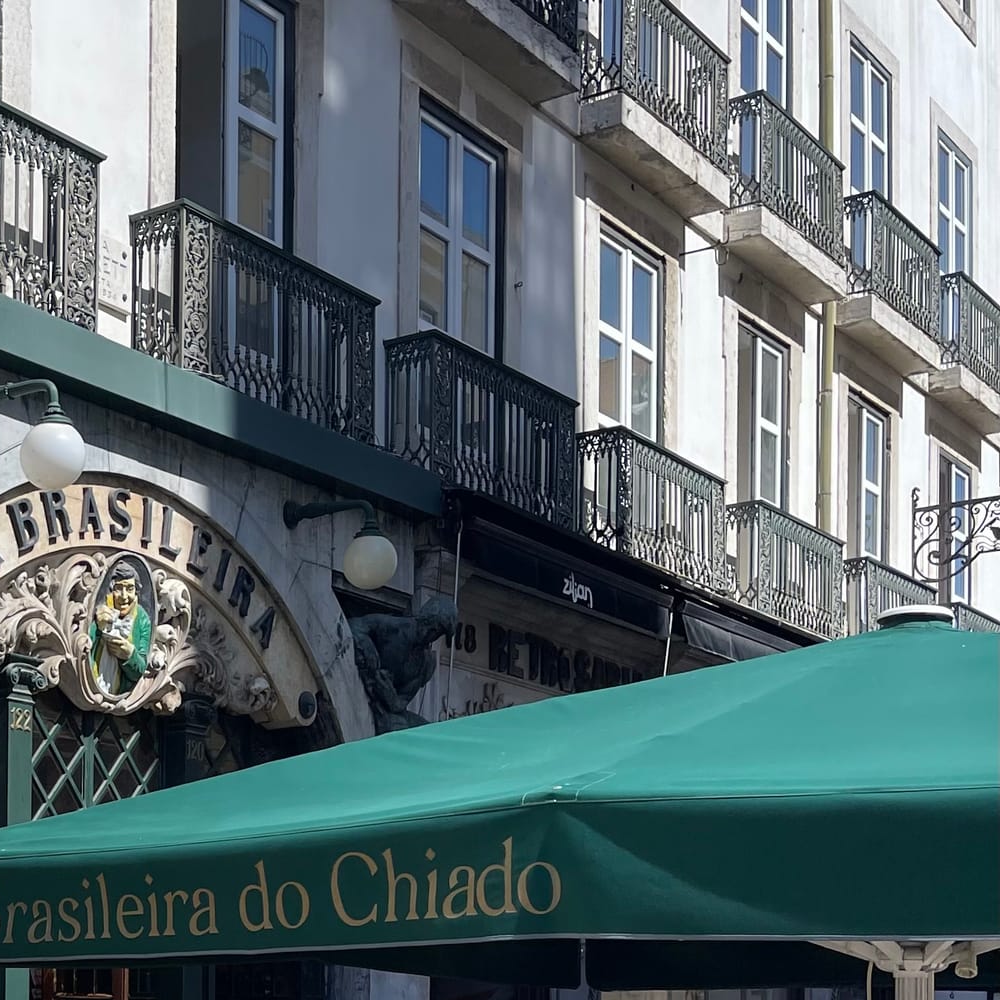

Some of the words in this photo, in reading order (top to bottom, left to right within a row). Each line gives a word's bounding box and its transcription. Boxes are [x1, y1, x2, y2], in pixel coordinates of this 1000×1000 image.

[6, 487, 276, 650] BRASILEIRA
[10, 706, 31, 732] 122
[238, 858, 310, 933] do
[330, 835, 564, 927] Chiado
